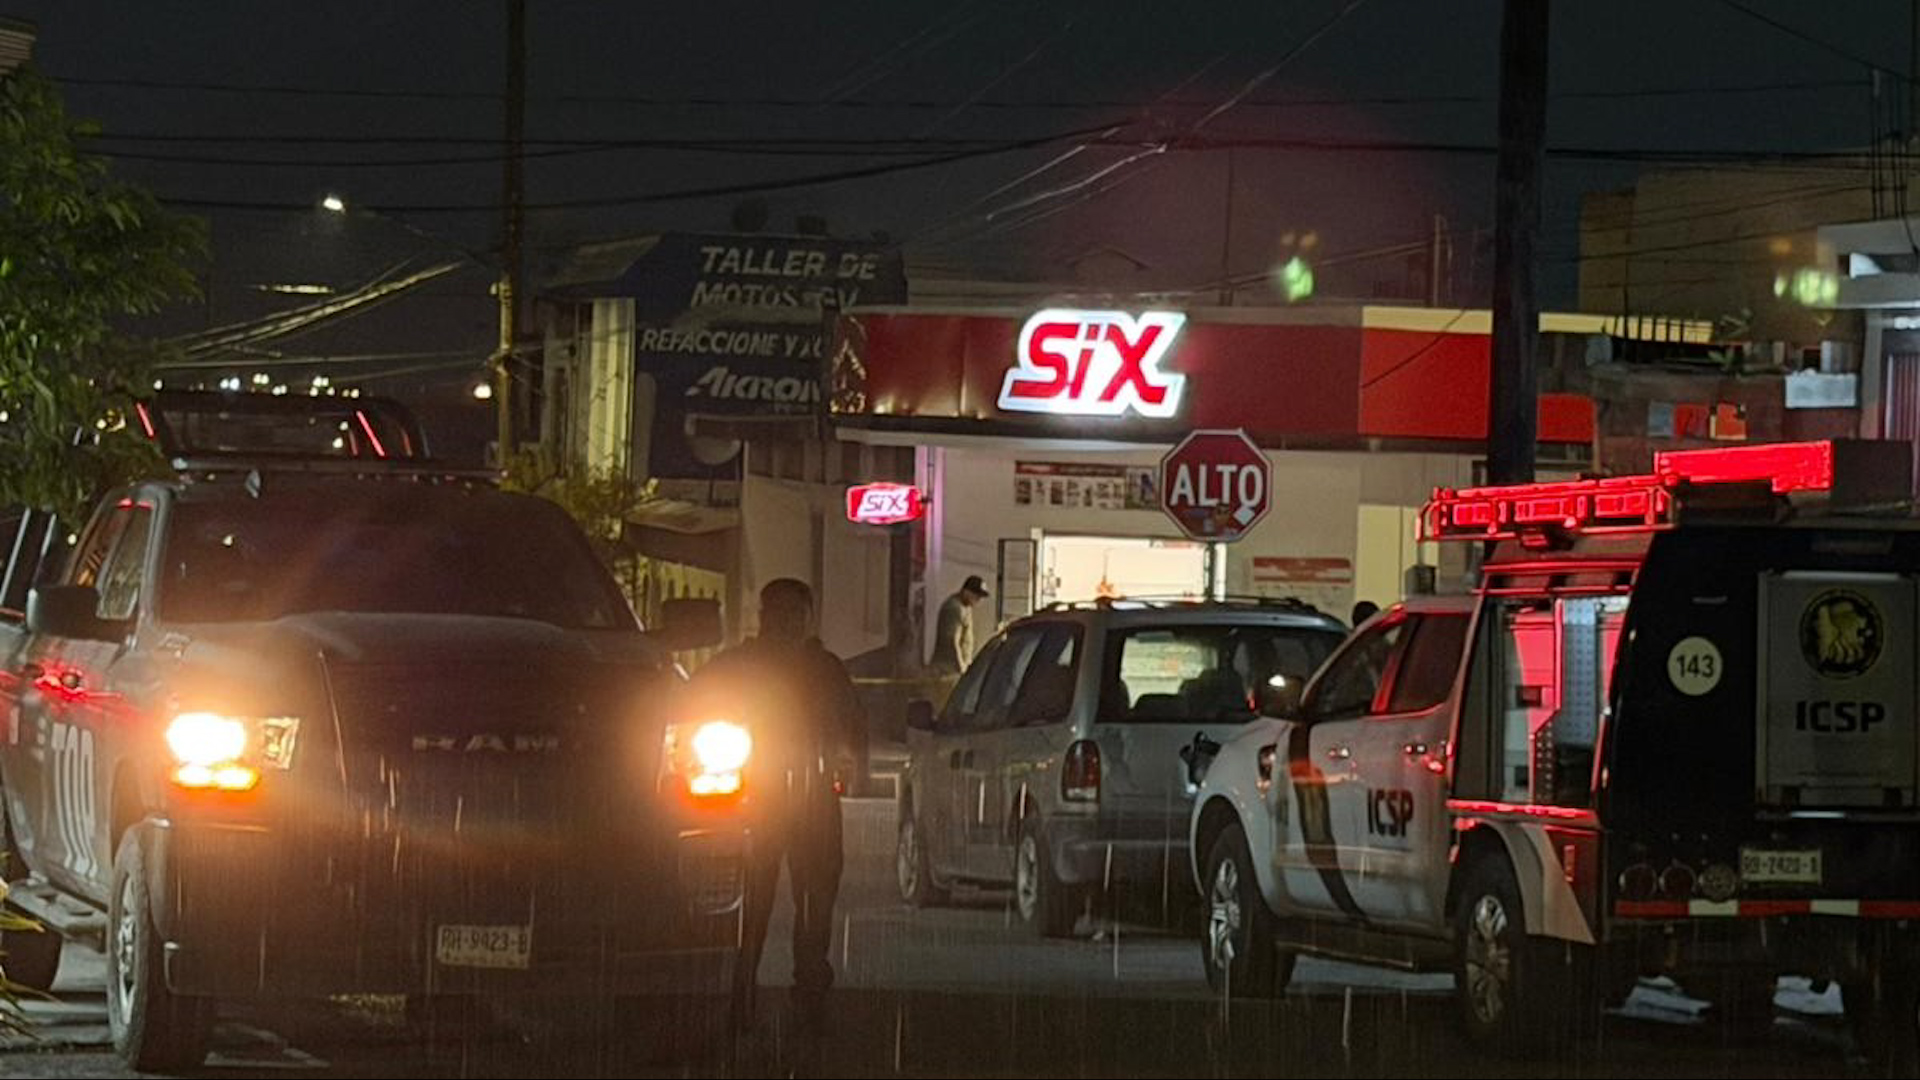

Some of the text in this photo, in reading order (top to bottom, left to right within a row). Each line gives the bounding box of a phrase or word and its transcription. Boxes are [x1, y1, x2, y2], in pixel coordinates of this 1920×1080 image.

[700, 245, 880, 280] TALLER DE
[690, 280, 800, 308] MOTOS
[1169, 462, 1264, 511] ALTO
[1676, 655, 1715, 679] 143
[1795, 700, 1884, 732] ICSP
[1367, 788, 1414, 838] ICSP
